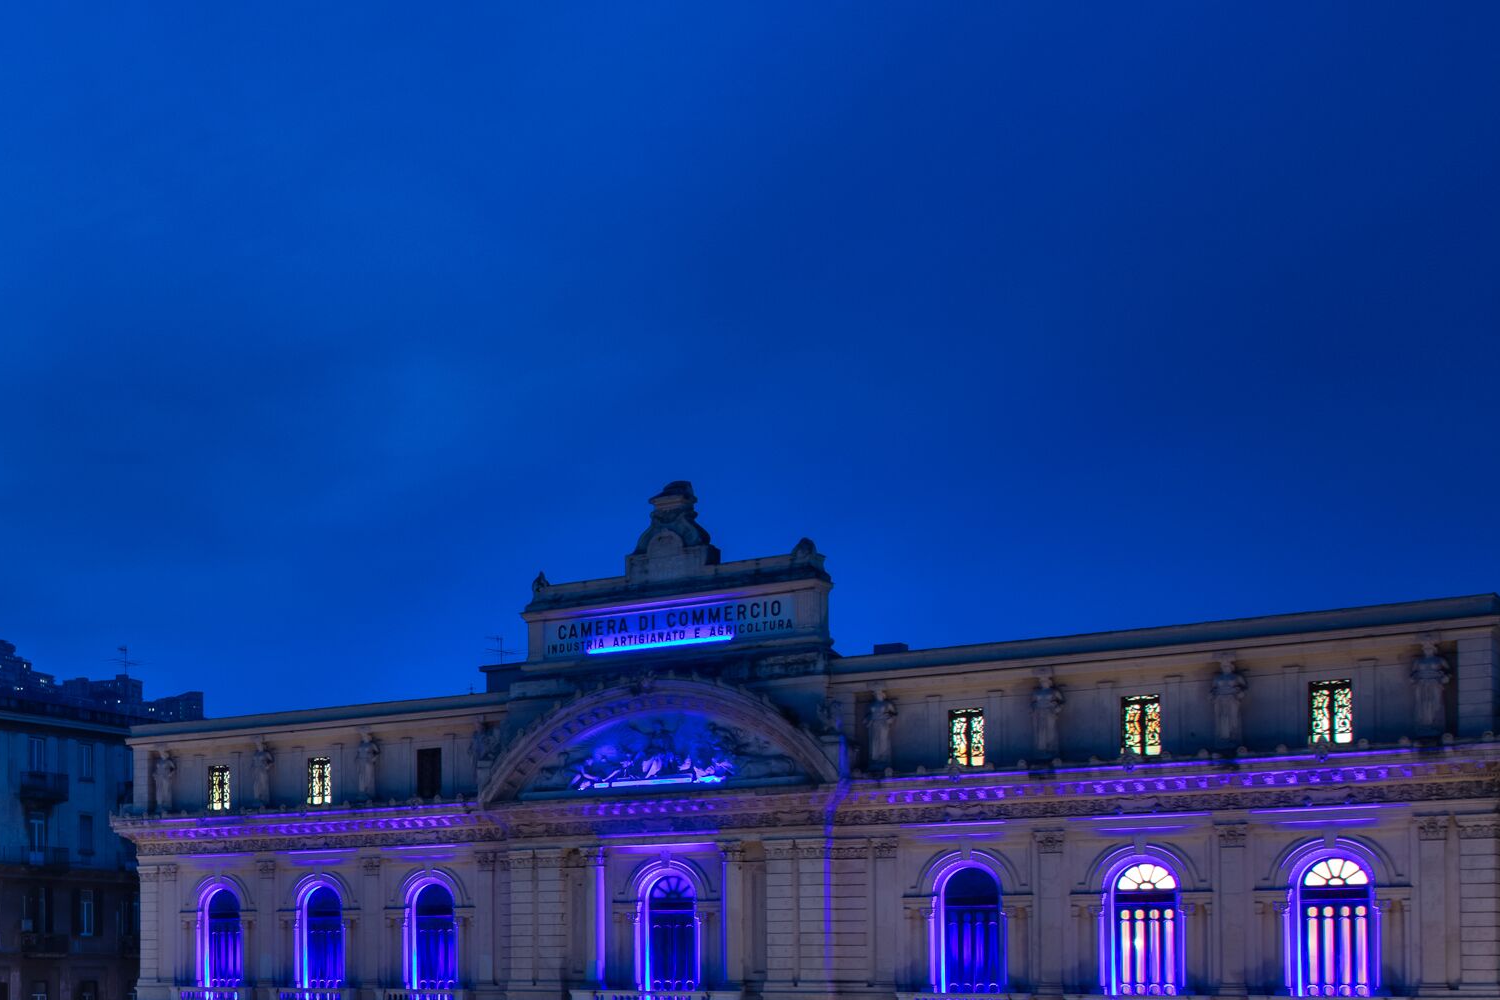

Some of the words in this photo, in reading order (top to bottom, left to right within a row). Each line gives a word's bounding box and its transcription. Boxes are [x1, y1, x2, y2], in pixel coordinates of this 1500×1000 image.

[547, 638, 605, 655] INDUSTRIA
[612, 629, 686, 648] ARTIGIANATO
[694, 628, 701, 639] E
[708, 618, 793, 637] AGRICOLTURA
[557, 617, 628, 640] CAMERA
[639, 615, 656, 631] DI
[666, 600, 781, 628] COMMERCIO
